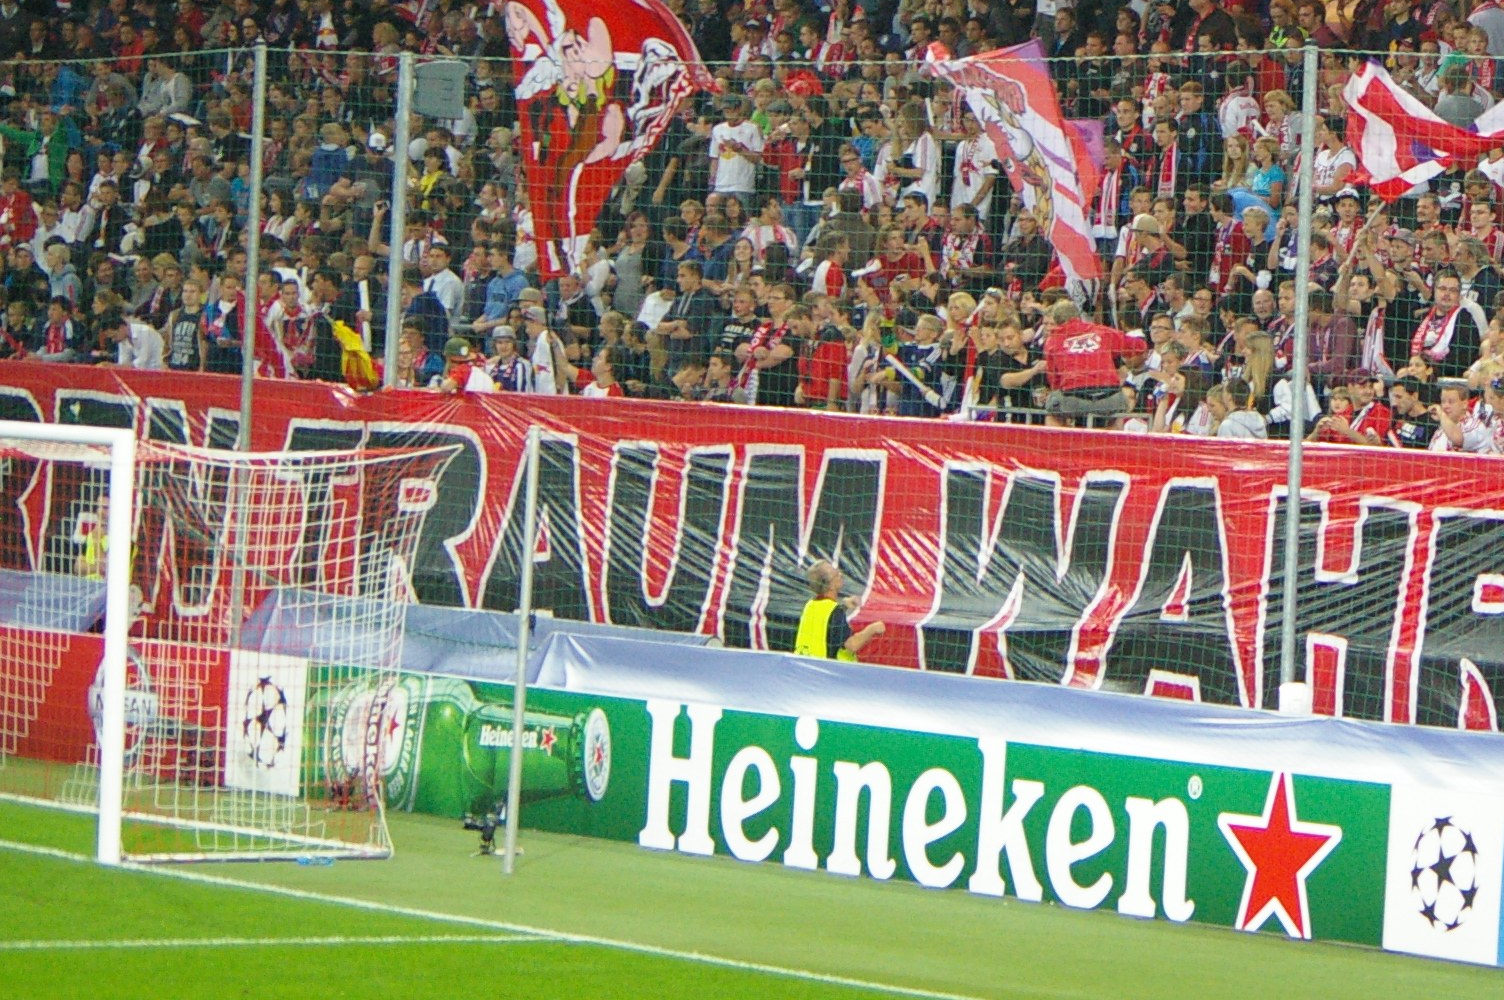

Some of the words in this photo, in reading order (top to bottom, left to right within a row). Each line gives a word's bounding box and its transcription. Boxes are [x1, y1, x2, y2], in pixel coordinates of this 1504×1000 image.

[274, 418, 888, 652] TRAUM
[479, 724, 538, 748] Heineen
[638, 700, 1196, 923] Heineken
